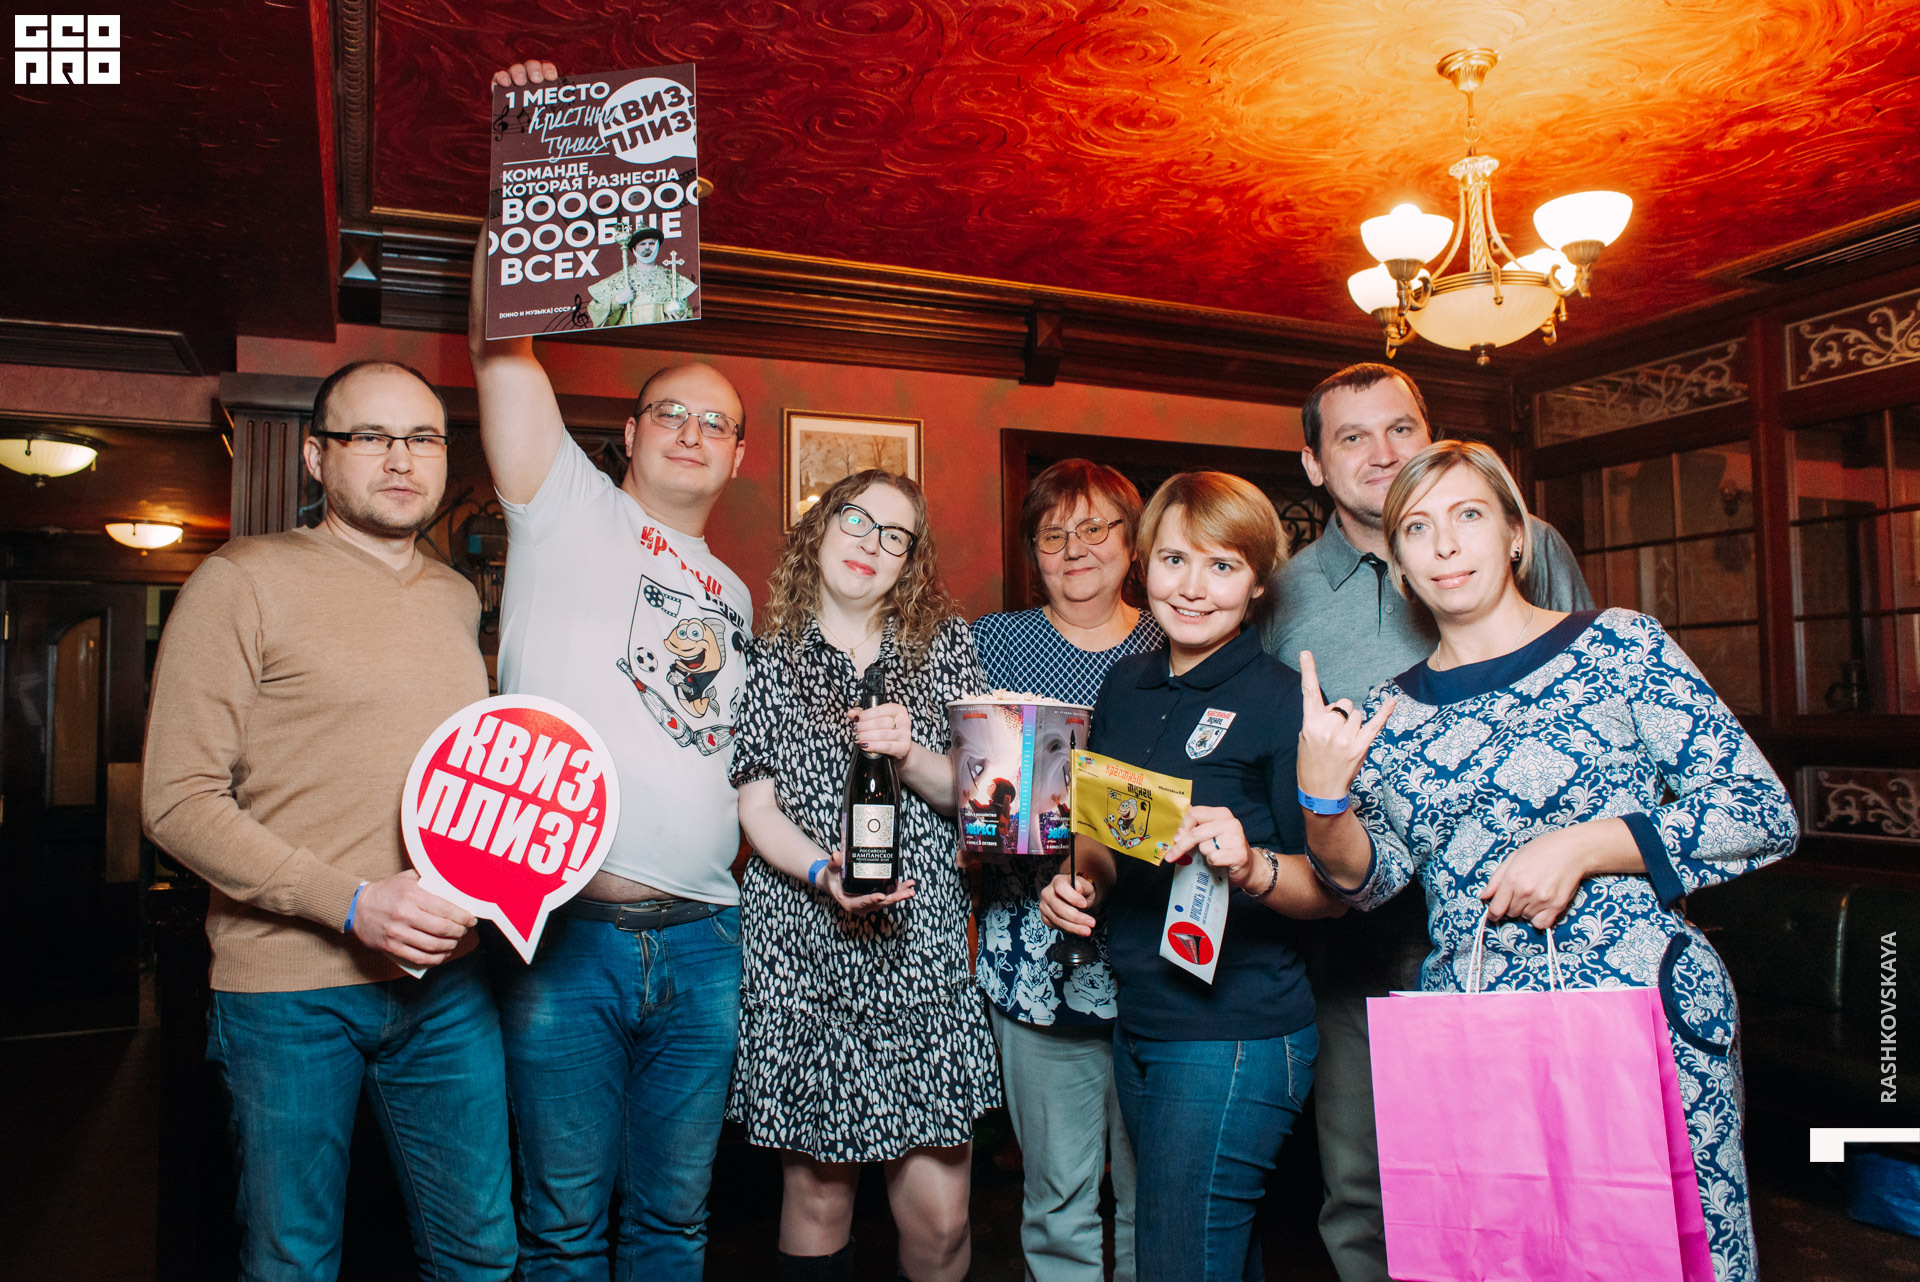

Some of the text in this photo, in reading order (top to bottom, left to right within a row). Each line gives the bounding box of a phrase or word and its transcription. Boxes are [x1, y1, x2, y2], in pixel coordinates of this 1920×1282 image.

[505, 81, 610, 109] 1 МЕСТО
[502, 162, 594, 184] КОМАНДЕ,
[502, 168, 680, 198] КОТОРАЯ РАЗНЕСЛА
[501, 249, 600, 286] ВСЕХ
[446, 715, 603, 823] КВИЗ,
[417, 768, 598, 883] ПЛИЗ!
